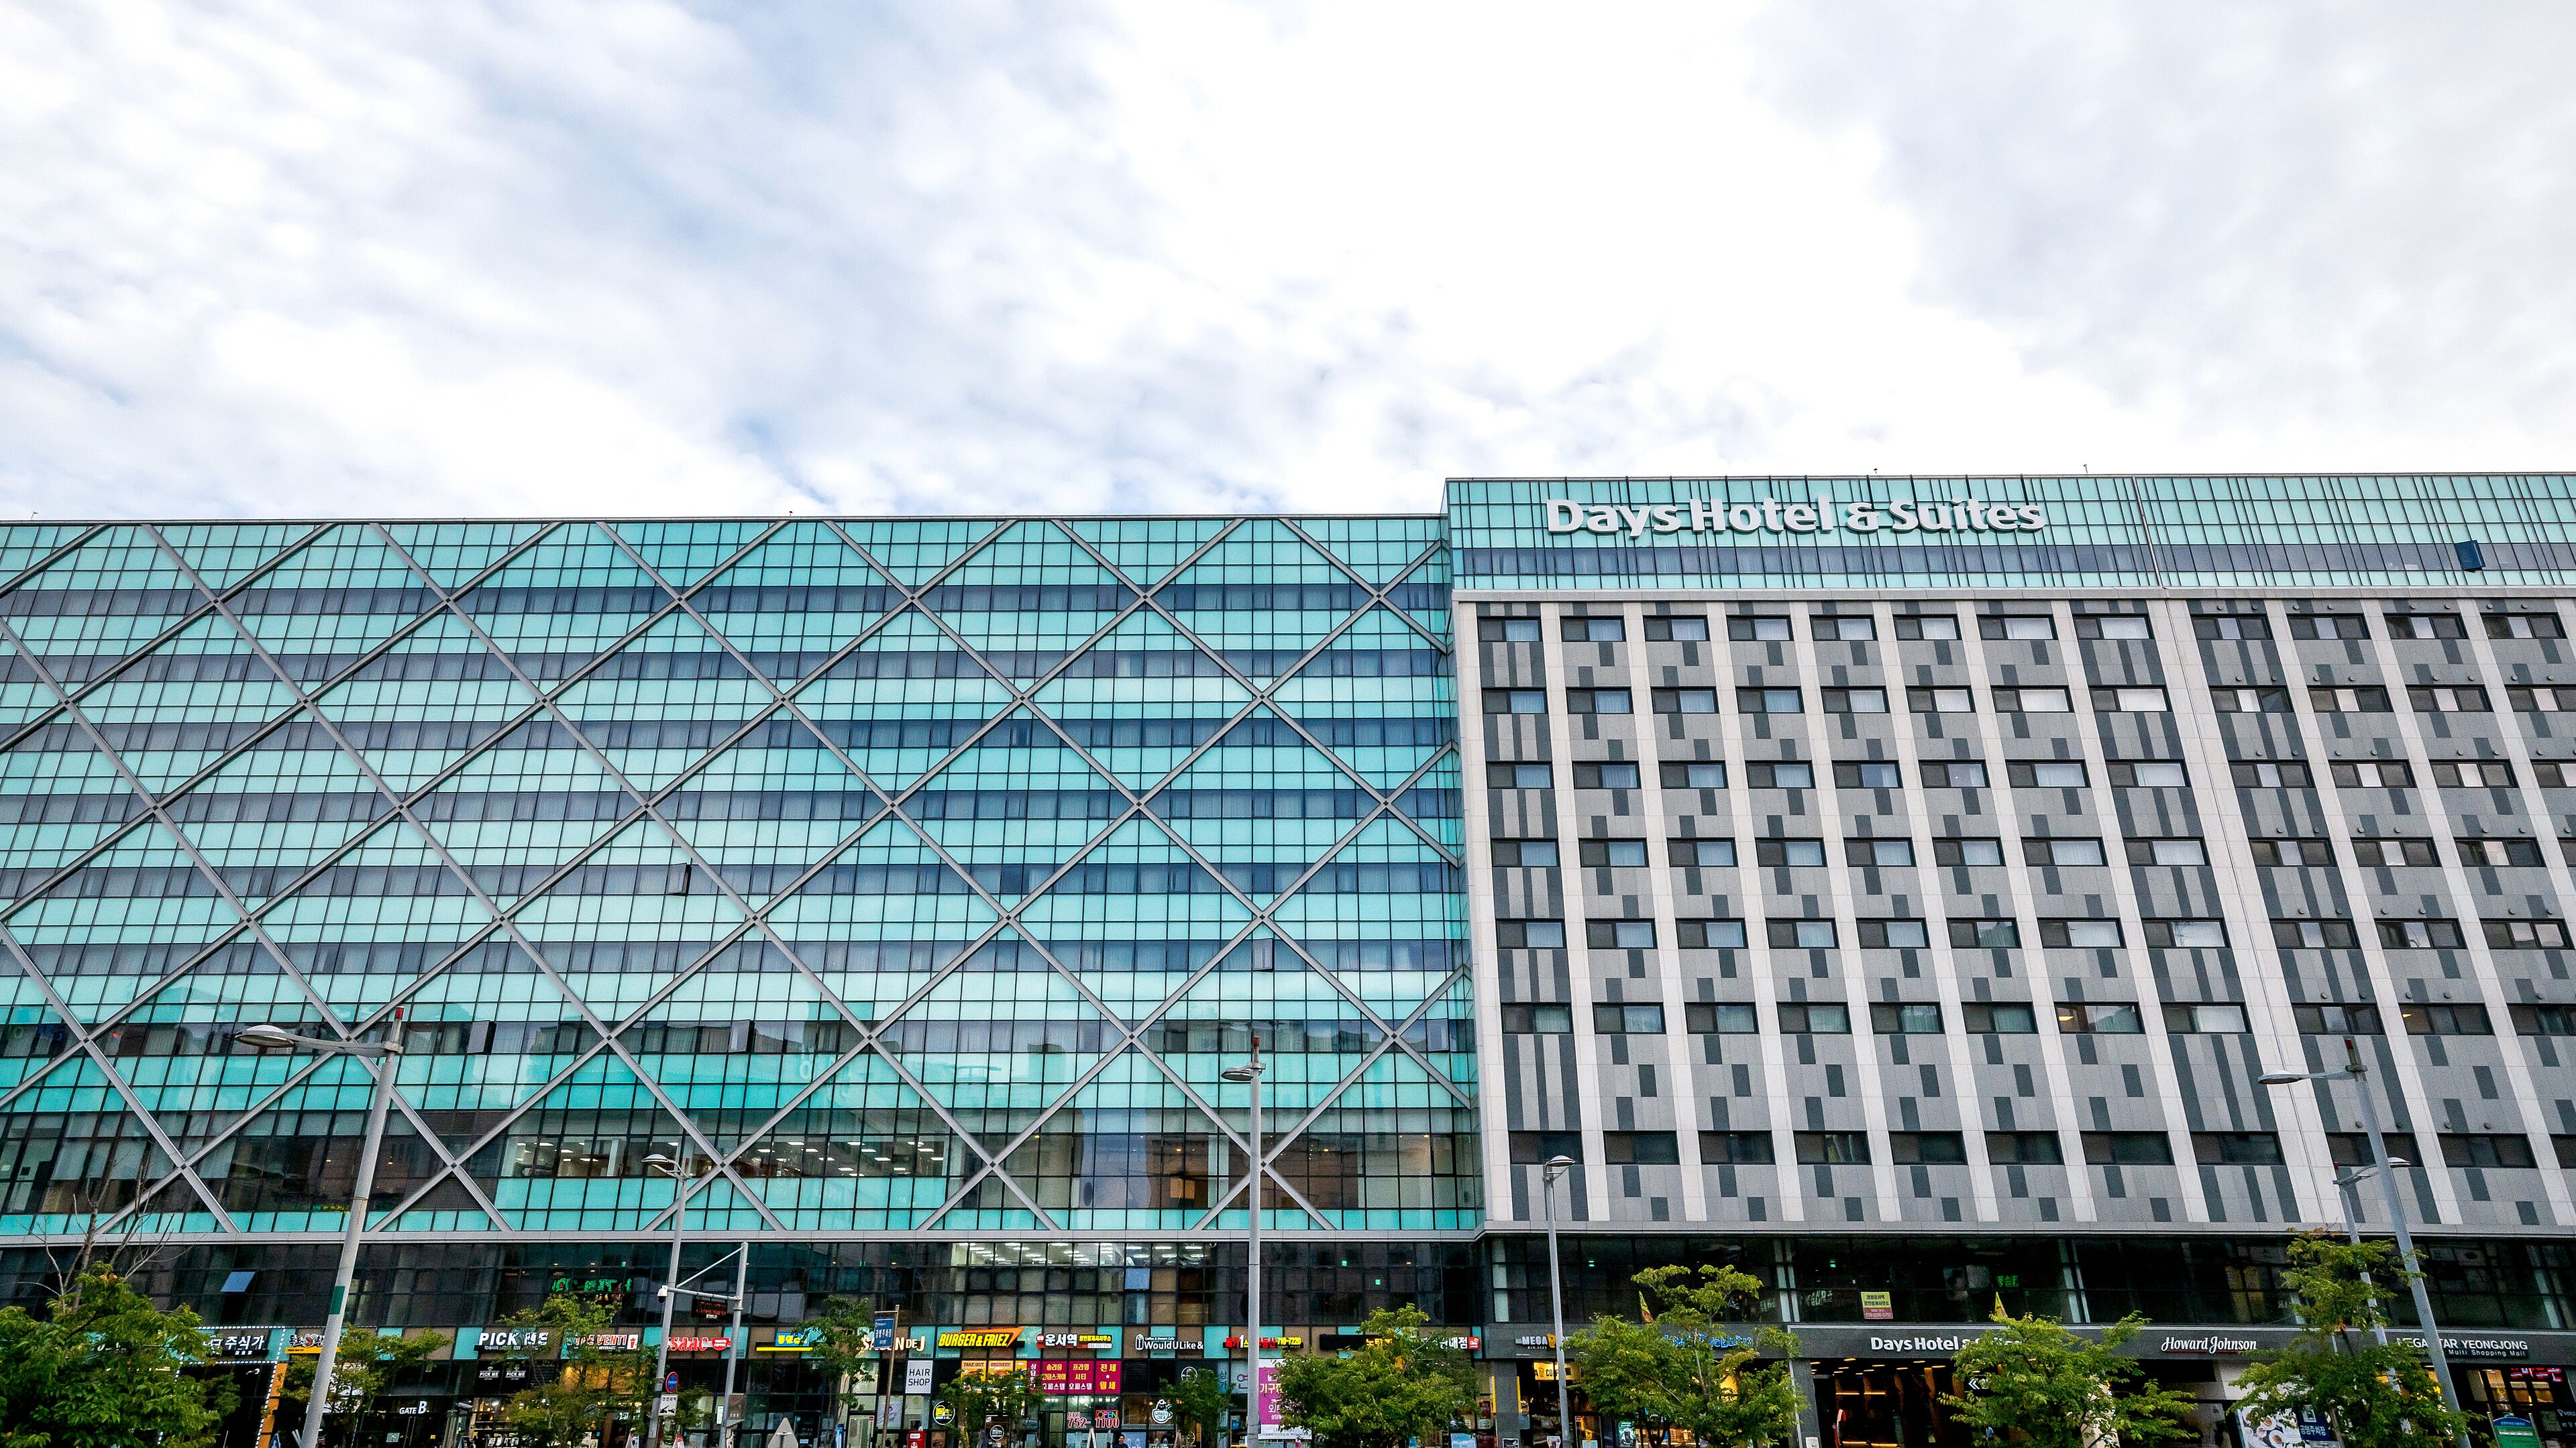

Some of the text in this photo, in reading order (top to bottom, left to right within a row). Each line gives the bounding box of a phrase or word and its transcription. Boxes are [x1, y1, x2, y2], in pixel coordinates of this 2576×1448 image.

[1546, 494, 2046, 537] Days Hotel & Suites
[225, 1335, 265, 1350] 주식가
[479, 1332, 549, 1345] PICK ME
[597, 1334, 628, 1345] VENTI
[667, 1336, 709, 1351] saac
[906, 1339, 918, 1348] DE
[916, 1335, 926, 1351] J
[1044, 1333, 1078, 1347] 운서역
[1277, 1337, 1302, 1345] 710-7220
[1522, 1336, 1548, 1345] MEGA
[1870, 1337, 1913, 1352] Days
[1915, 1335, 1959, 1350] Hotel
[2161, 1336, 2257, 1353] Howard Johnson
[2461, 1340, 2528, 1350] YEONGJONG
[909, 1368, 930, 1376] HAIR
[908, 1378, 930, 1387] SHOP
[399, 1400, 427, 1414] GATE B
[1096, 1410, 1118, 1418] OPEN
[1095, 1417, 1120, 1429] 1100
